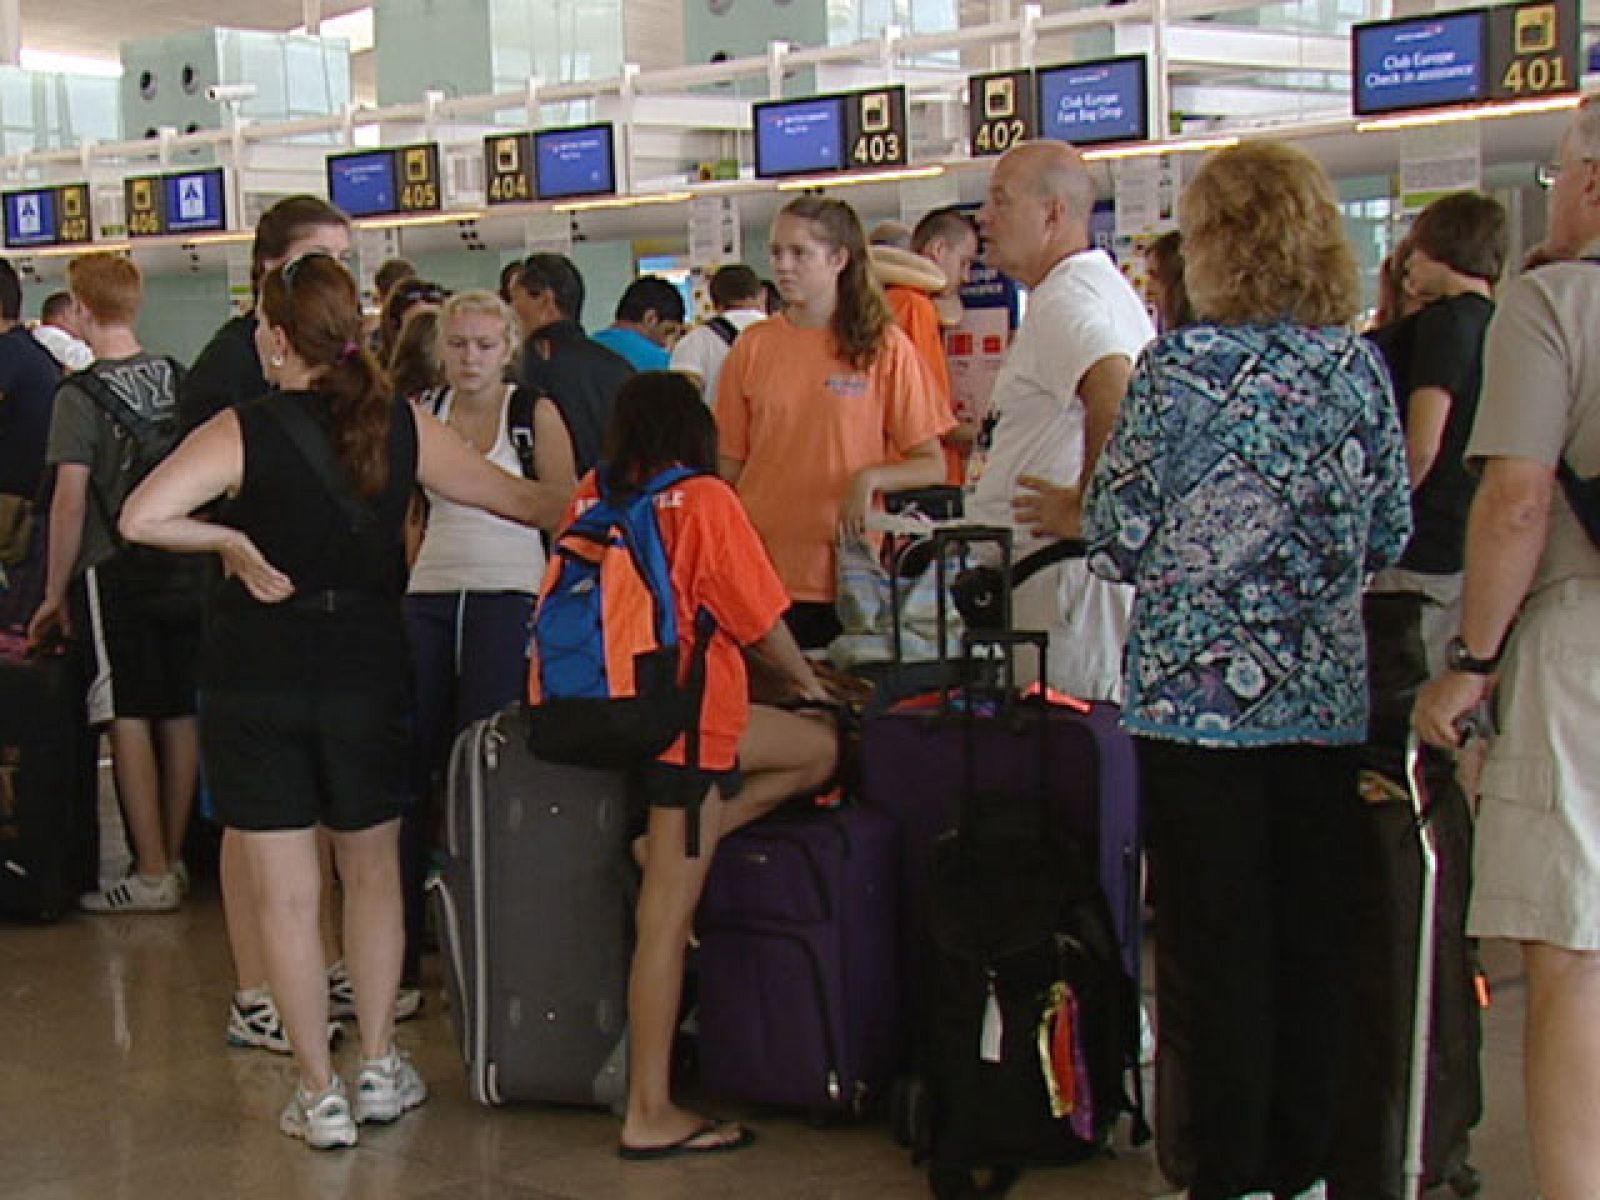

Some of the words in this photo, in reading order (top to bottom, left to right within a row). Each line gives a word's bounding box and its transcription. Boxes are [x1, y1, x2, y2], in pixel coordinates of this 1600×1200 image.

[1383, 53, 1412, 71] Club
[1414, 51, 1456, 68] Europe
[1504, 56, 1566, 93] 401
[1059, 95, 1083, 110] Club
[854, 133, 900, 162] 403
[975, 119, 1026, 151] 402
[401, 182, 437, 209] 405
[489, 174, 529, 200] 404
